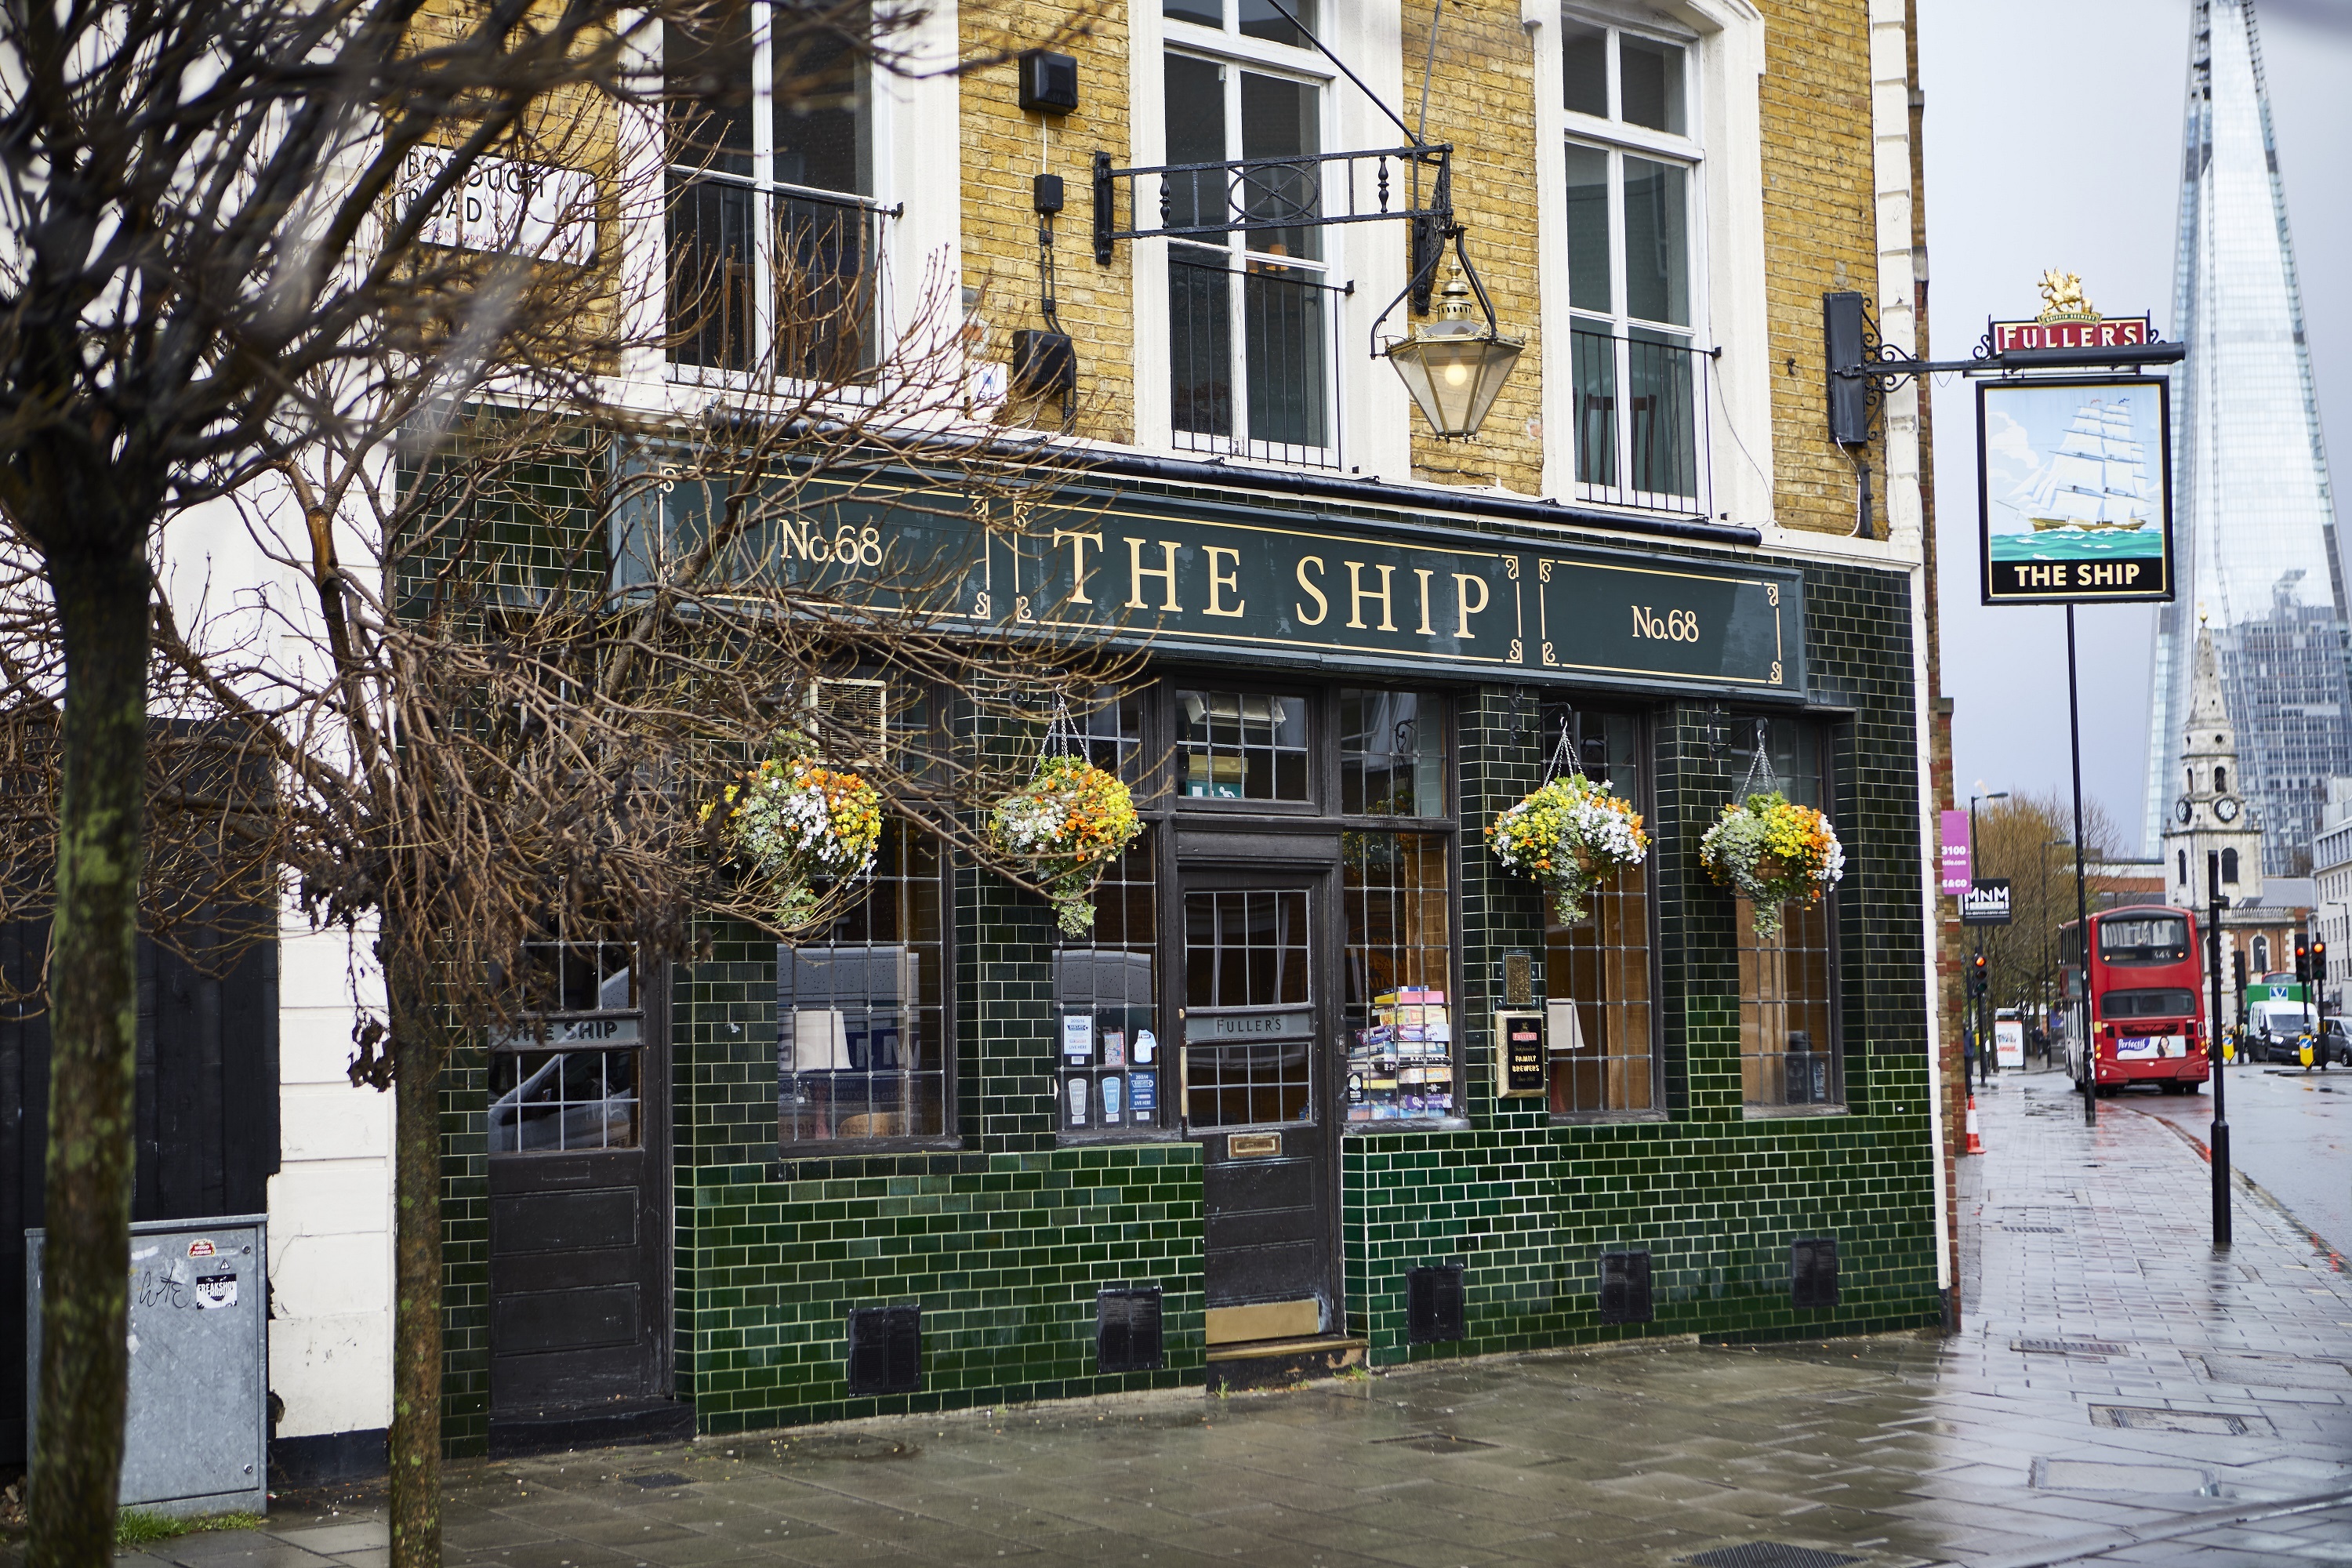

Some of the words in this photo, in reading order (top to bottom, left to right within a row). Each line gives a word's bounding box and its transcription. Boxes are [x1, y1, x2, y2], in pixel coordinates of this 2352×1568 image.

[408, 152, 543, 198] BOOUGH
[459, 232, 506, 246] OROUGH
[524, 242, 585, 260] SOTHARK
[2004, 321, 2139, 350] FULLER'S
[779, 519, 883, 567] No.68
[1054, 527, 1245, 618] THE
[1296, 556, 1490, 639] SHIP
[2014, 564, 2067, 587] THE
[2077, 564, 2140, 586] SHIP
[1631, 605, 1700, 643] No.68
[512, 1022, 554, 1041] THE
[564, 1021, 618, 1040] SHIP
[1217, 1017, 1282, 1033] FULLER'S
